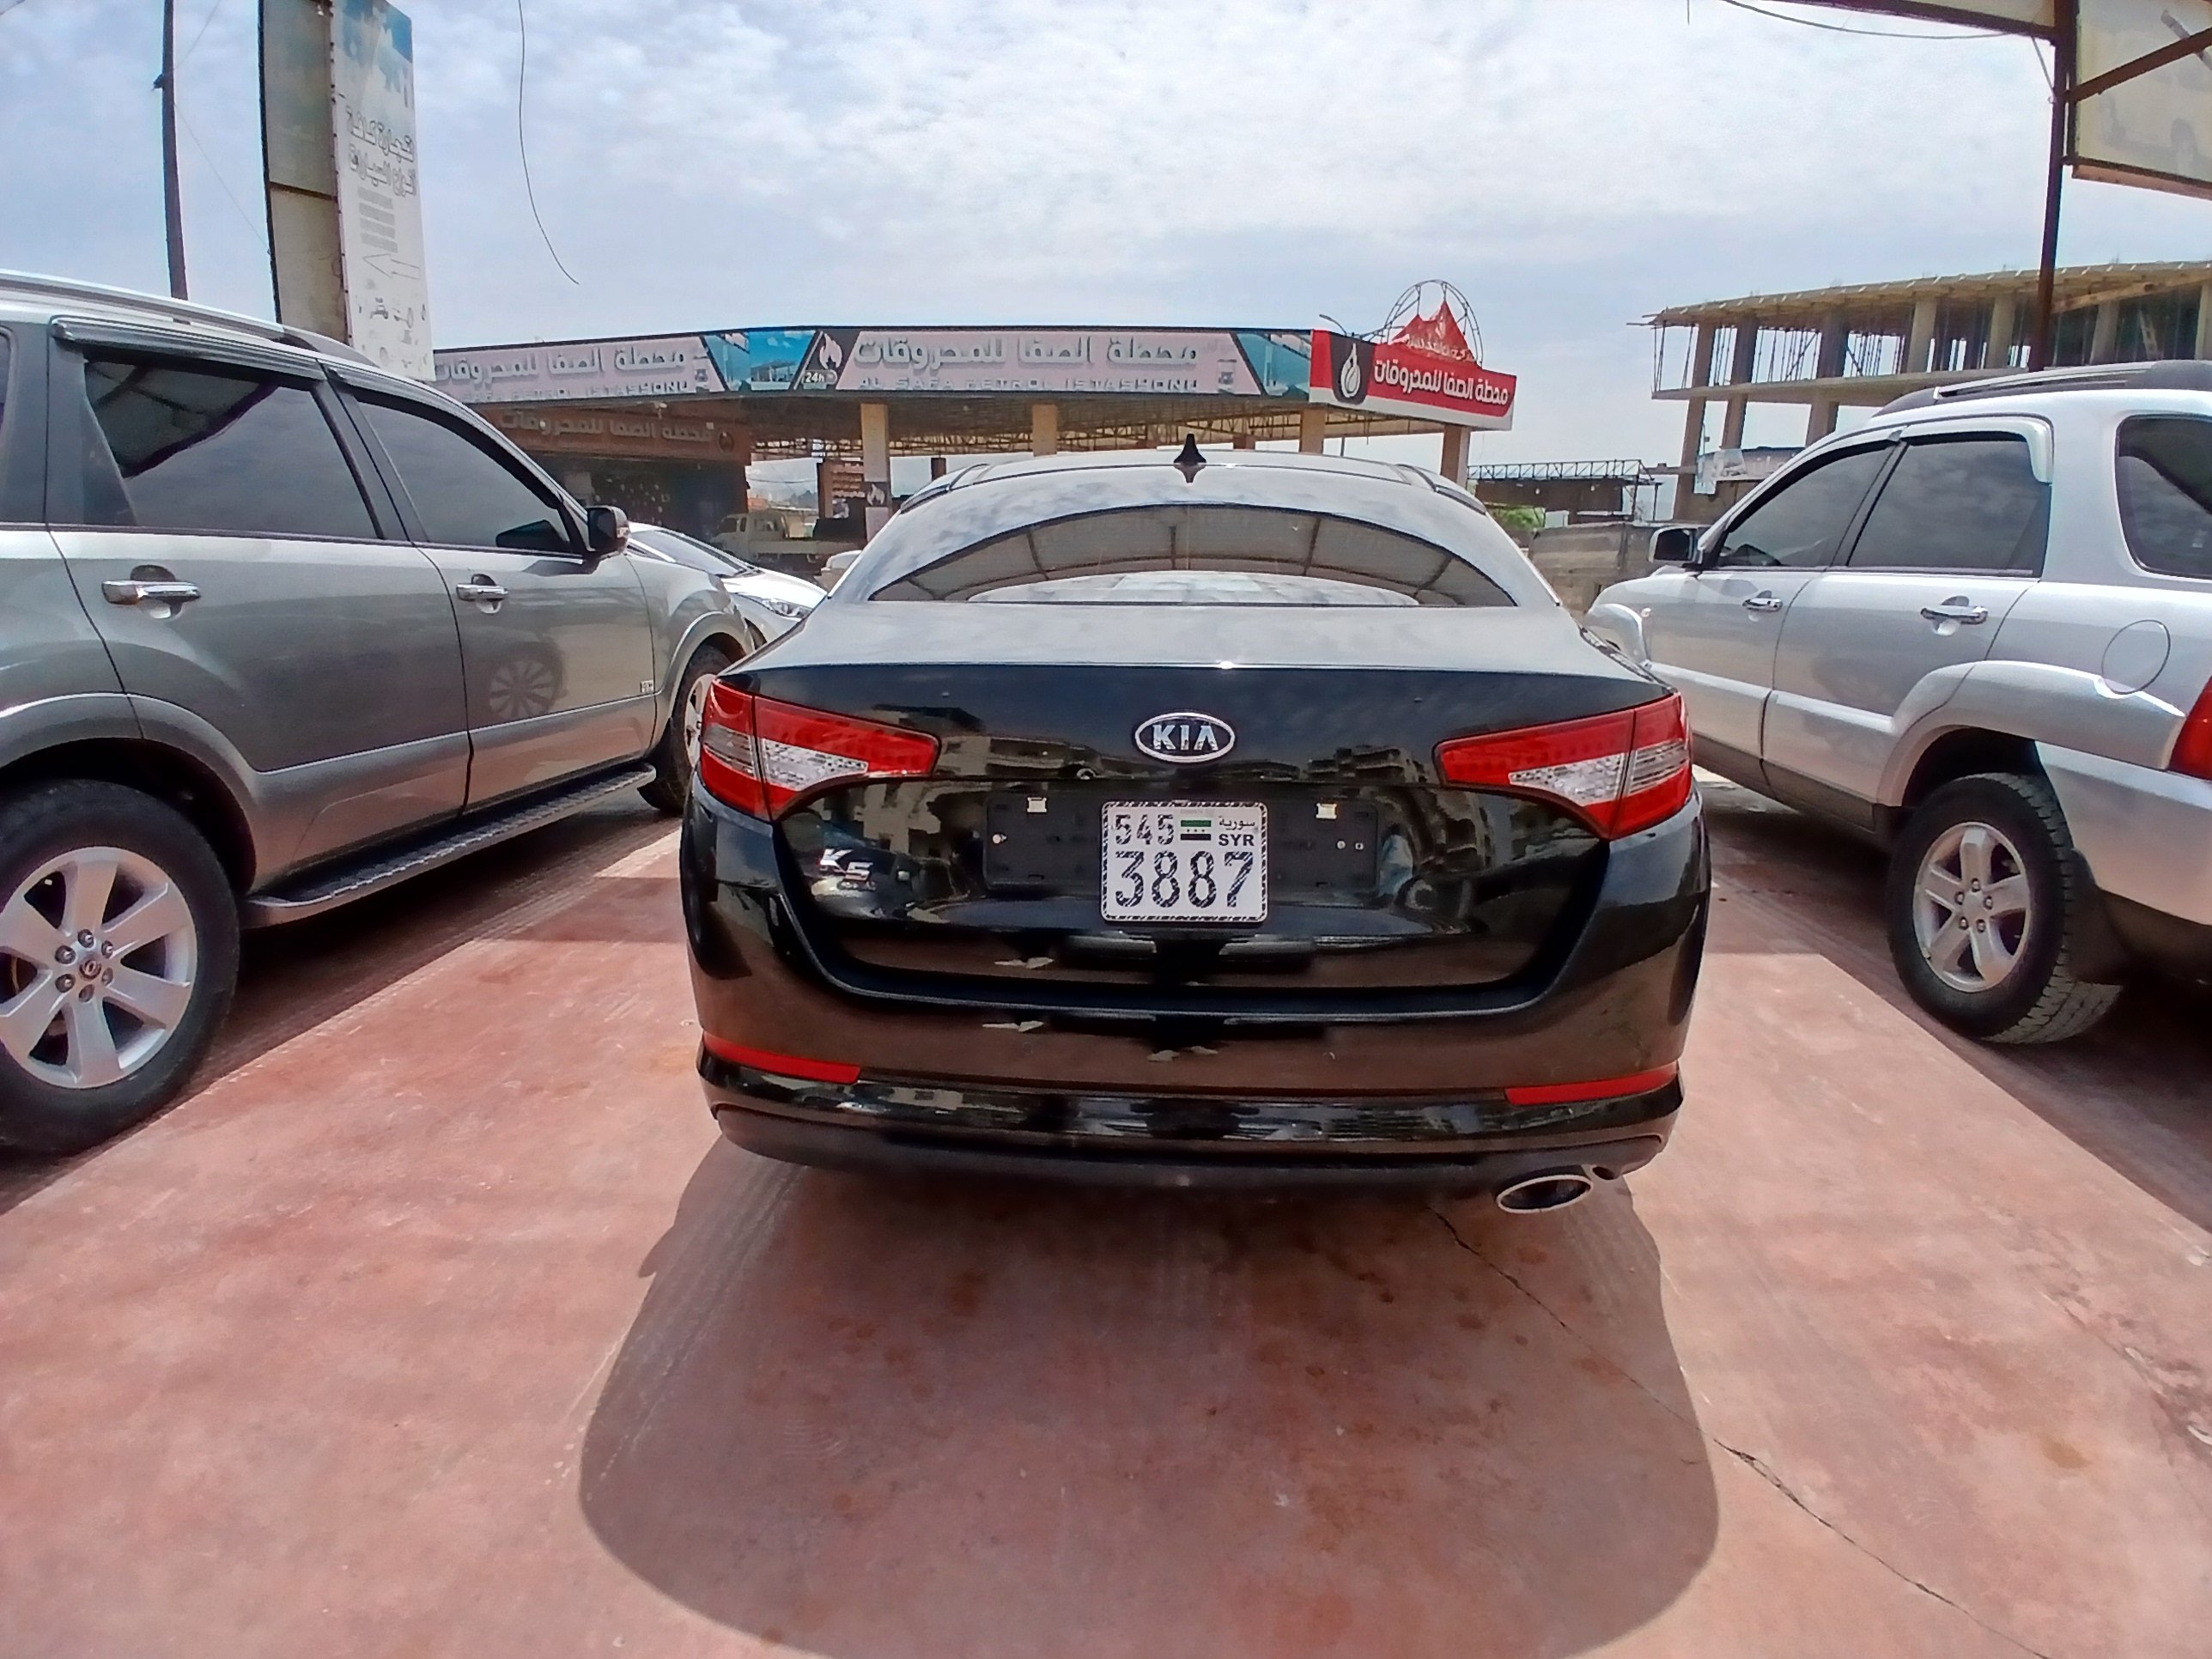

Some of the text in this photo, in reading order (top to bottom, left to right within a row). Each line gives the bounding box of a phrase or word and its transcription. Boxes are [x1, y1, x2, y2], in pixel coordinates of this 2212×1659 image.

[548, 347, 603, 374] الصفا
[615, 346, 684, 370] محطة
[854, 336, 1007, 370] للمحروقات
[1018, 336, 1091, 364] الصفا
[1107, 336, 1197, 366] محطة
[805, 372, 825, 383] 24h
[896, 377, 953, 390] SAFA
[1374, 359, 1509, 405] محطة الصفا للمحروقات
[1152, 724, 1219, 750] KIA
[1115, 813, 1175, 846] 545
[1218, 815, 1255, 831] سورية
[1218, 833, 1255, 847] SYR
[819, 848, 874, 881] K5
[1115, 850, 1254, 908] 3887
